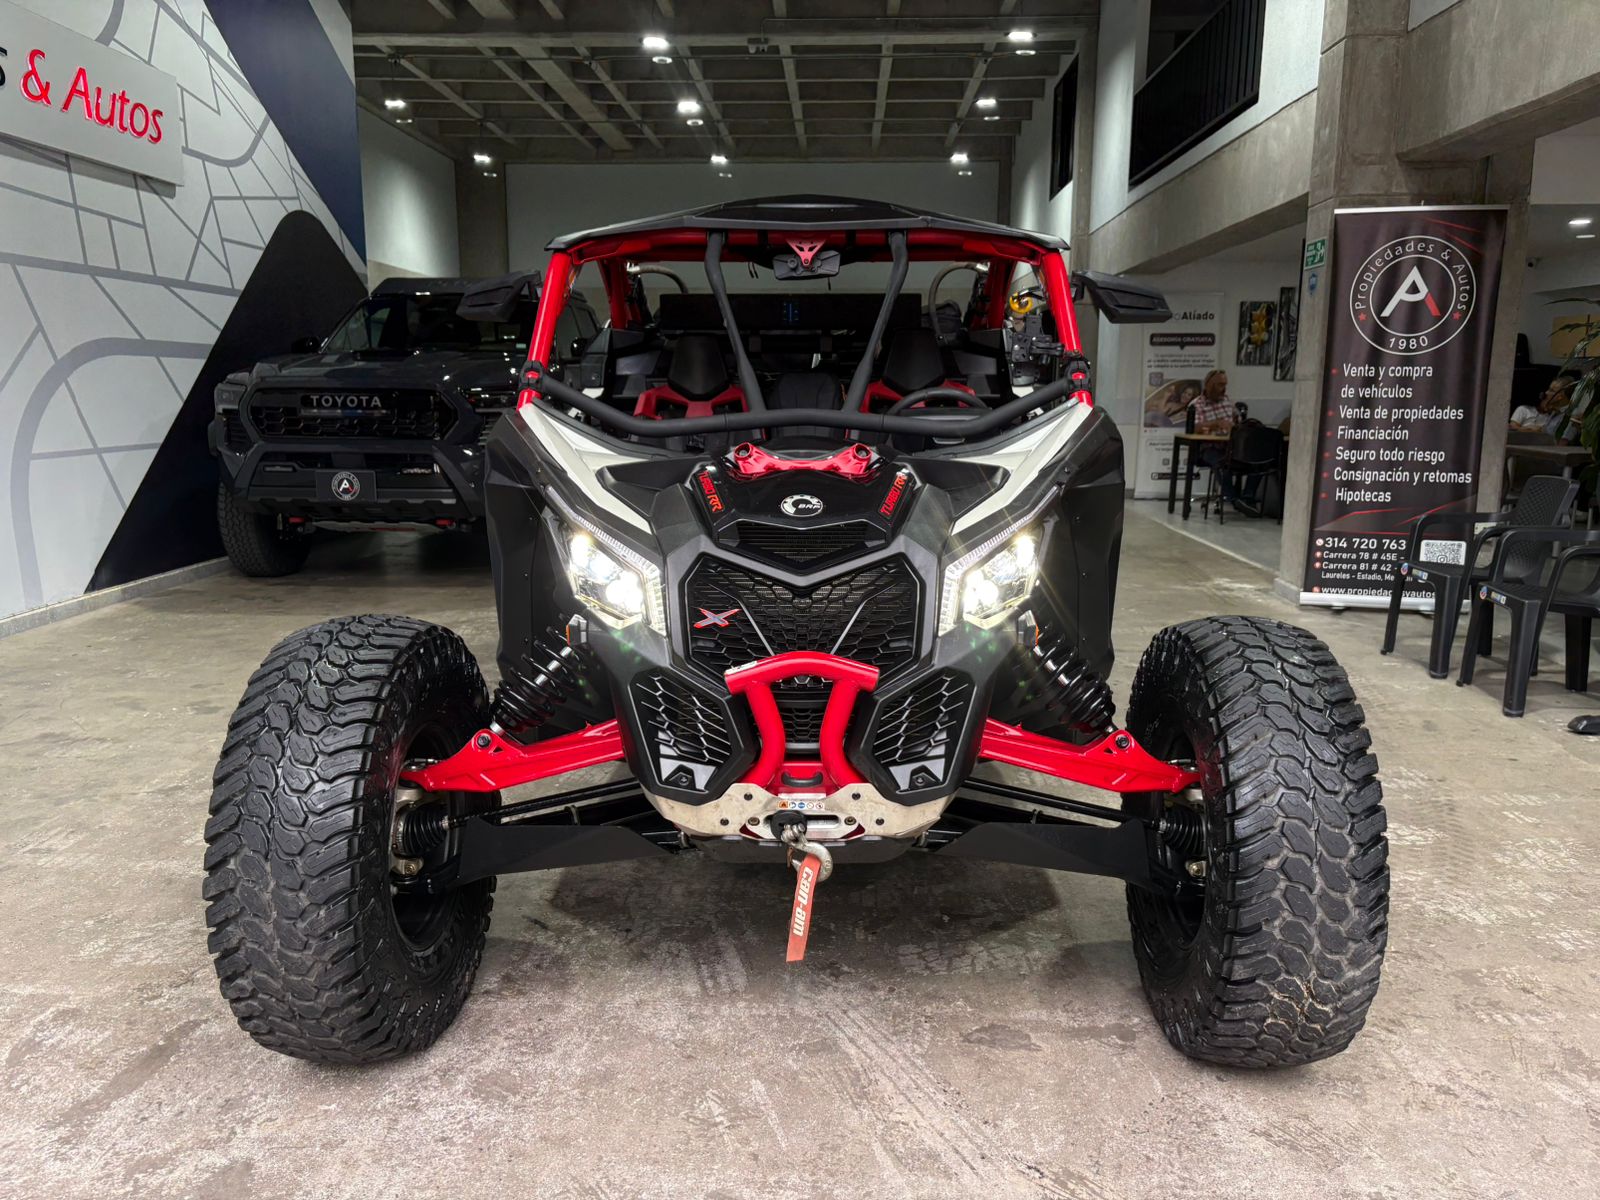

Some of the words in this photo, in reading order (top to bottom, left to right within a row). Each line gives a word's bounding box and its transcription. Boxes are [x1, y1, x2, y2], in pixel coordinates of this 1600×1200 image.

[20, 48, 52, 107] &
[61, 66, 165, 144] Autos
[1355, 240, 1435, 310] Propiedades
[1440, 248, 1452, 261] &
[1452, 264, 1471, 311] Autos
[1389, 335, 1429, 350] 1980
[1343, 363, 1376, 377] Venta
[1378, 366, 1386, 381] y
[1388, 366, 1433, 380] compra
[1340, 384, 1355, 398] de
[1358, 383, 1413, 398] vehículos
[310, 395, 382, 407] TOYOTA
[1339, 405, 1371, 419] Venta
[1374, 405, 1389, 419] de
[1391, 405, 1464, 423] propiedades
[1337, 425, 1409, 440] Financiación
[1335, 446, 1376, 463] Seguro
[1379, 447, 1405, 461] todo
[1408, 448, 1446, 465] riesgo
[1334, 467, 1410, 485] Consignación
[1413, 471, 1420, 486] y
[1423, 470, 1473, 483] retomas
[1335, 487, 1392, 504] Hipotecas
[1324, 537, 1348, 549] 314
[1352, 538, 1377, 549] 720
[1323, 551, 1357, 559] Carrera
[1359, 552, 1370, 560] 78
[1380, 553, 1398, 561] 45E
[1322, 562, 1357, 570] Carrera
[1321, 571, 1350, 579] Laureles
[1356, 572, 1383, 582] Estadio,
[792, 866, 814, 937] can-am
